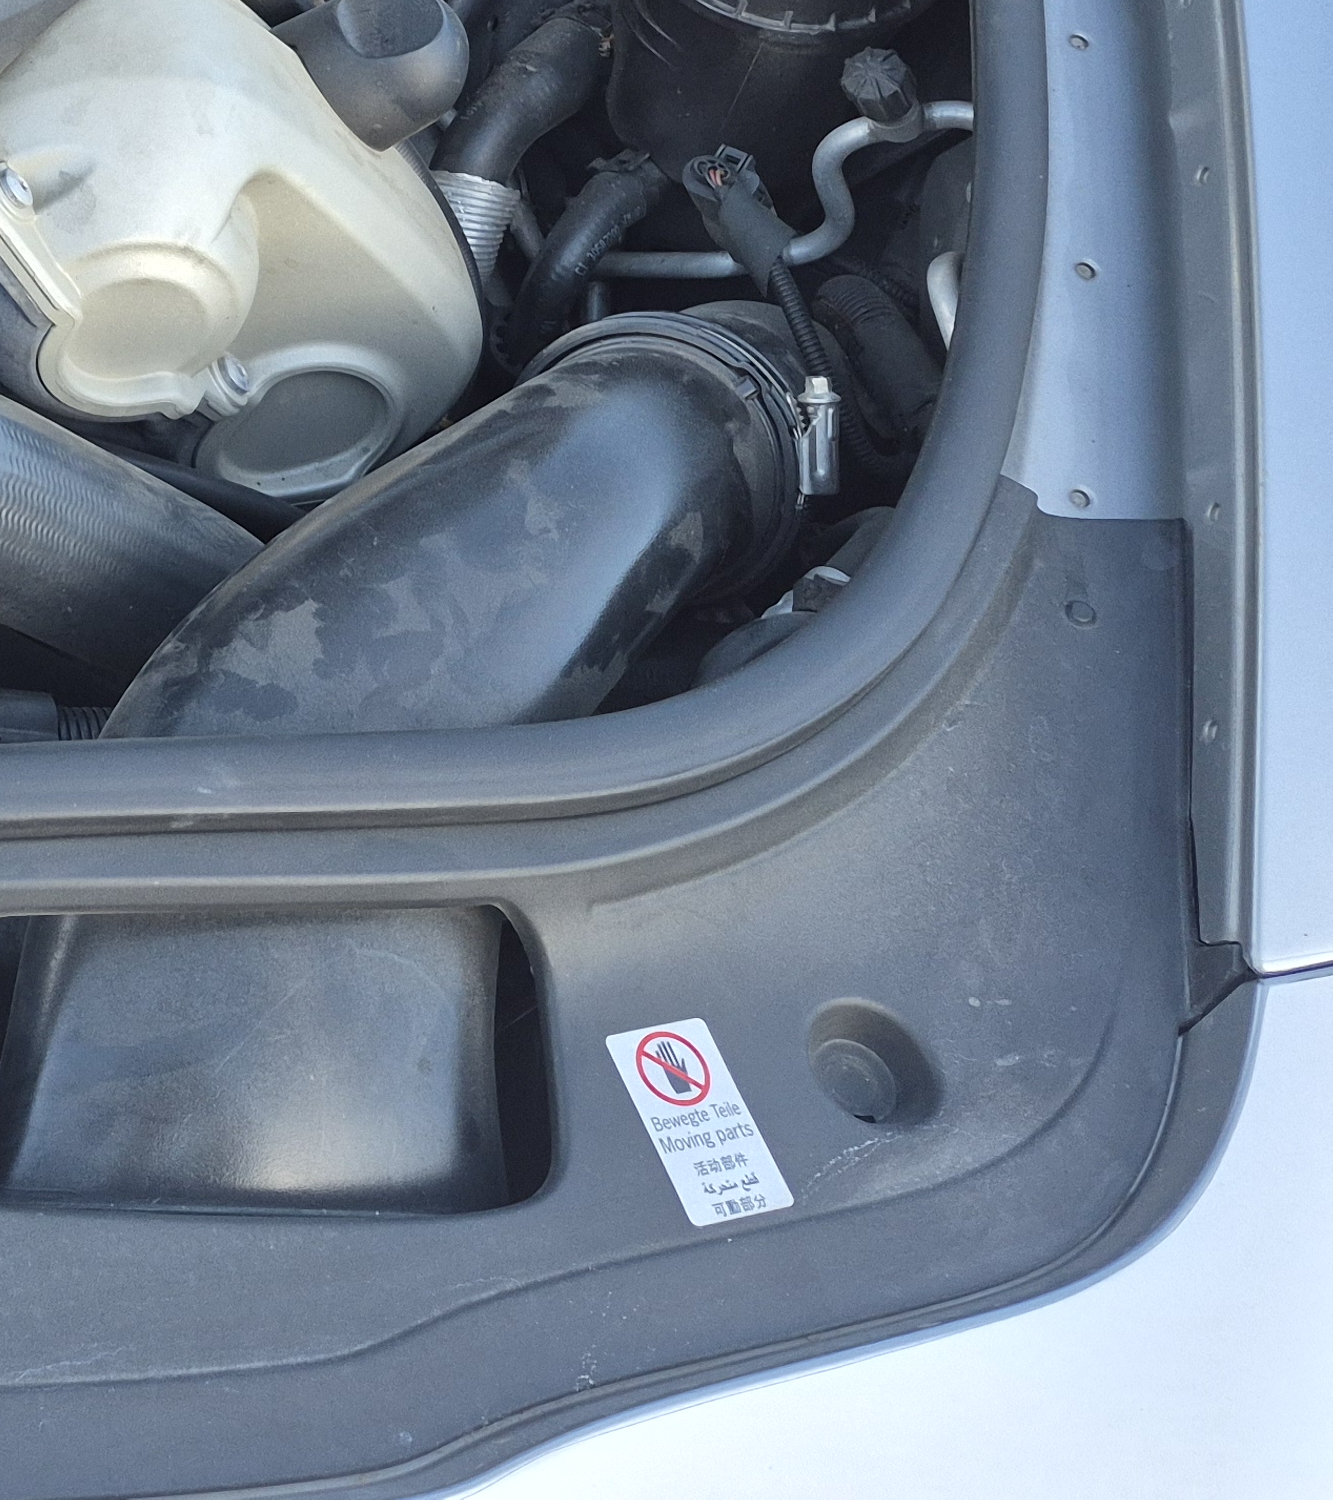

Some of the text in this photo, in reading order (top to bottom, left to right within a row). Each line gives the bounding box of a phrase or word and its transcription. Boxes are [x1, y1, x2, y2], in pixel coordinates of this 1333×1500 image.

[650, 1101, 741, 1132] Bewegte Teile
[659, 1122, 754, 1154] Moving parts
[693, 1152, 748, 1177] 活动部件
